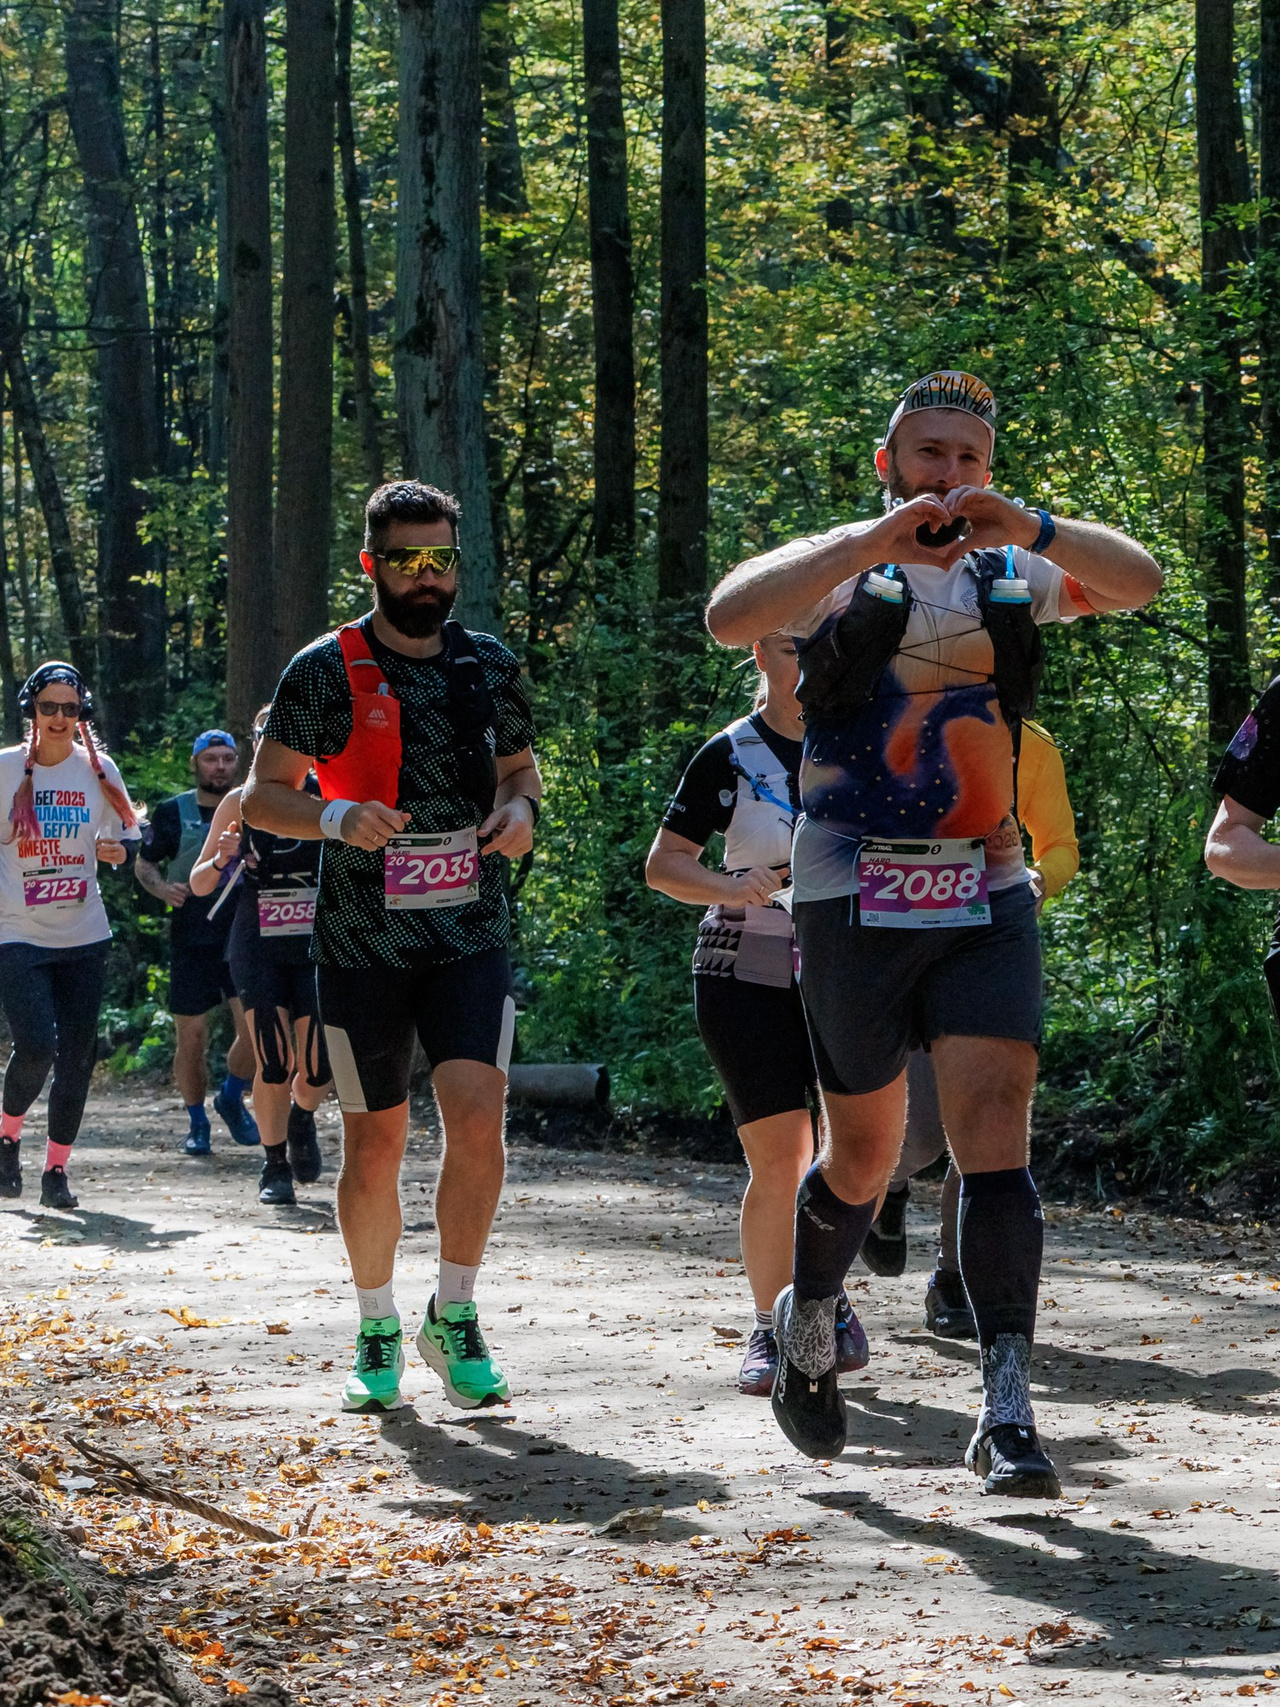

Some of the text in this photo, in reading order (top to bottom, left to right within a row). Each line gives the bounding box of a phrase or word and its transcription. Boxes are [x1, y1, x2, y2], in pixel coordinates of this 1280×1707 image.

[911, 376, 974, 409] ЛЁГКИХ
[43, 823, 80, 839] БЕГУТ
[17, 839, 61, 858] ВМЕСТЕ
[387, 856, 405, 866] 20
[399, 852, 475, 885] 2035
[862, 864, 885, 876] 20
[36, 879, 82, 899] 2123
[873, 867, 982, 901] 2088
[266, 902, 316, 921] 2058
